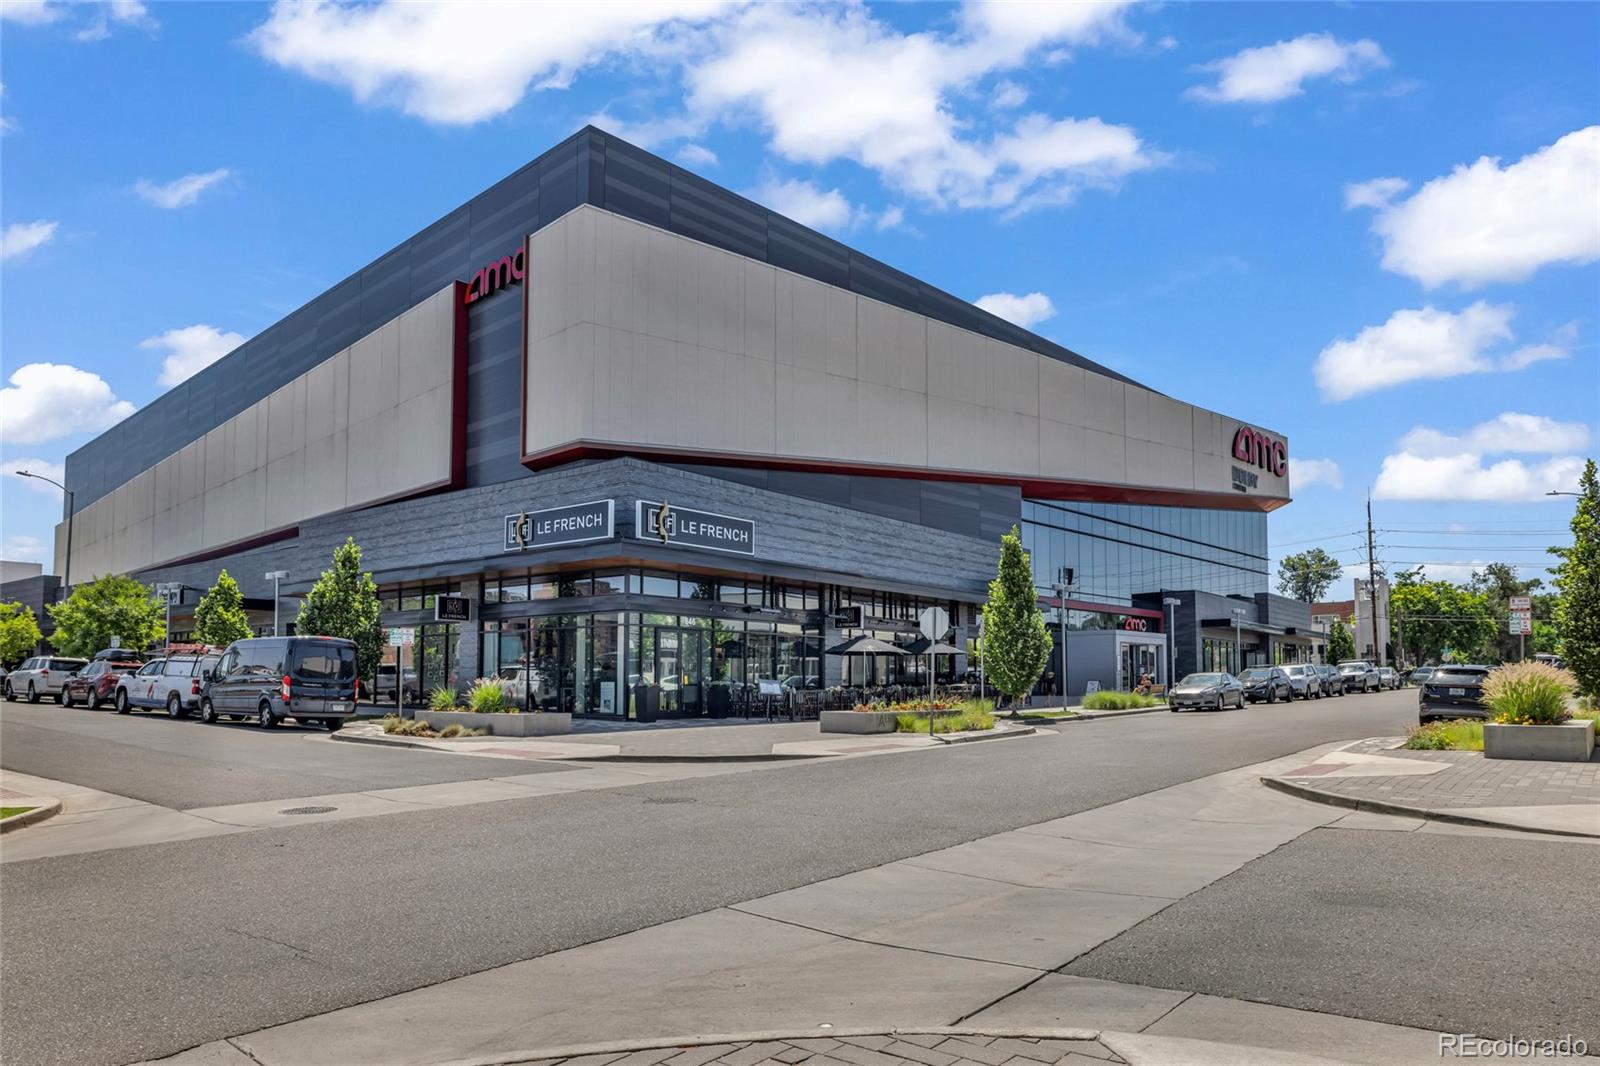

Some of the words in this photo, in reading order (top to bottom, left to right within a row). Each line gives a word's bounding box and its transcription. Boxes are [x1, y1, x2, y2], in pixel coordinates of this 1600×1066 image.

[1232, 426, 1287, 477] amc
[537, 520, 552, 535] LE
[554, 513, 602, 532] FRENCH
[681, 520, 697, 535] LE
[700, 523, 748, 542] FRENCH
[1125, 617, 1147, 632] amc
